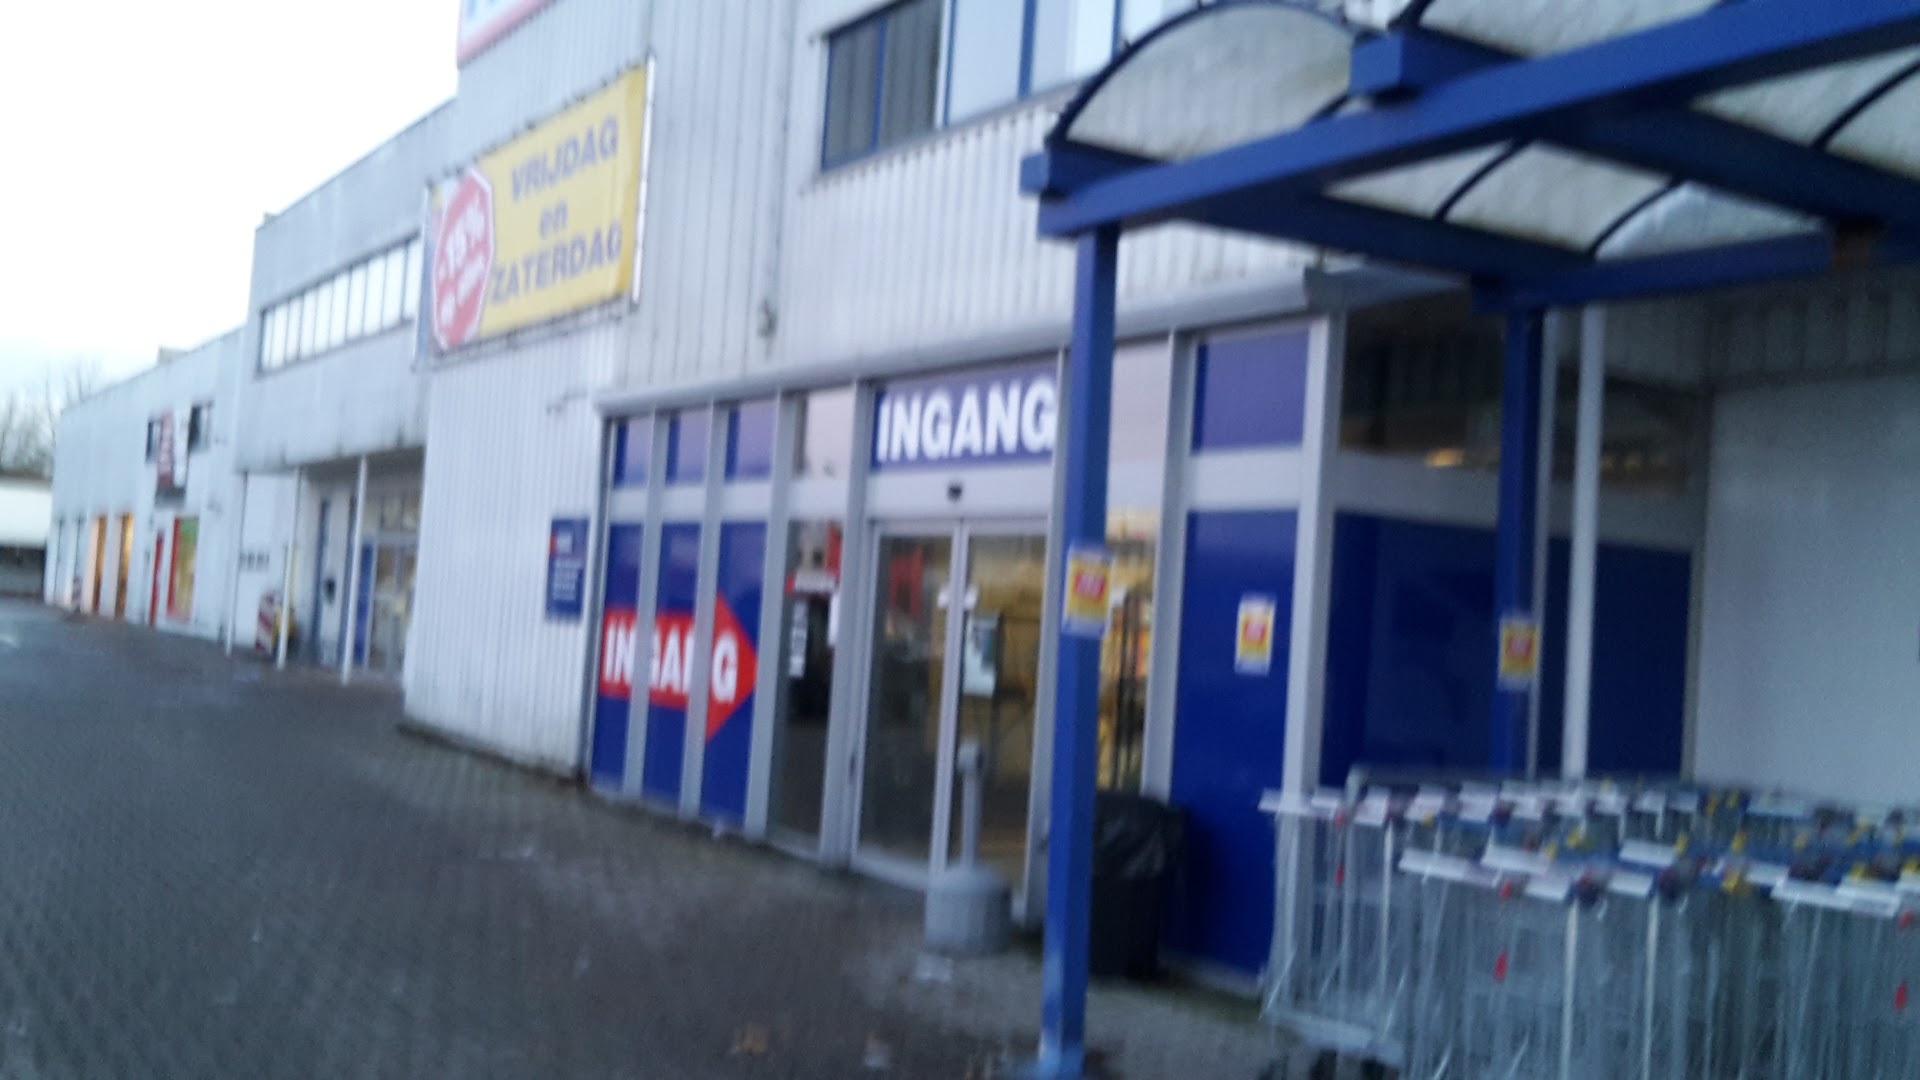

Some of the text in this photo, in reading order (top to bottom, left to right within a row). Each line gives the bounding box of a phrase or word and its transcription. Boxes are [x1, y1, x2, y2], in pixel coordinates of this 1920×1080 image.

[511, 116, 619, 202] VRIJDAG
[491, 221, 623, 303] ZATERDAG
[538, 203, 569, 238] en
[876, 376, 1057, 463] INGANG
[603, 620, 739, 703] INAG
